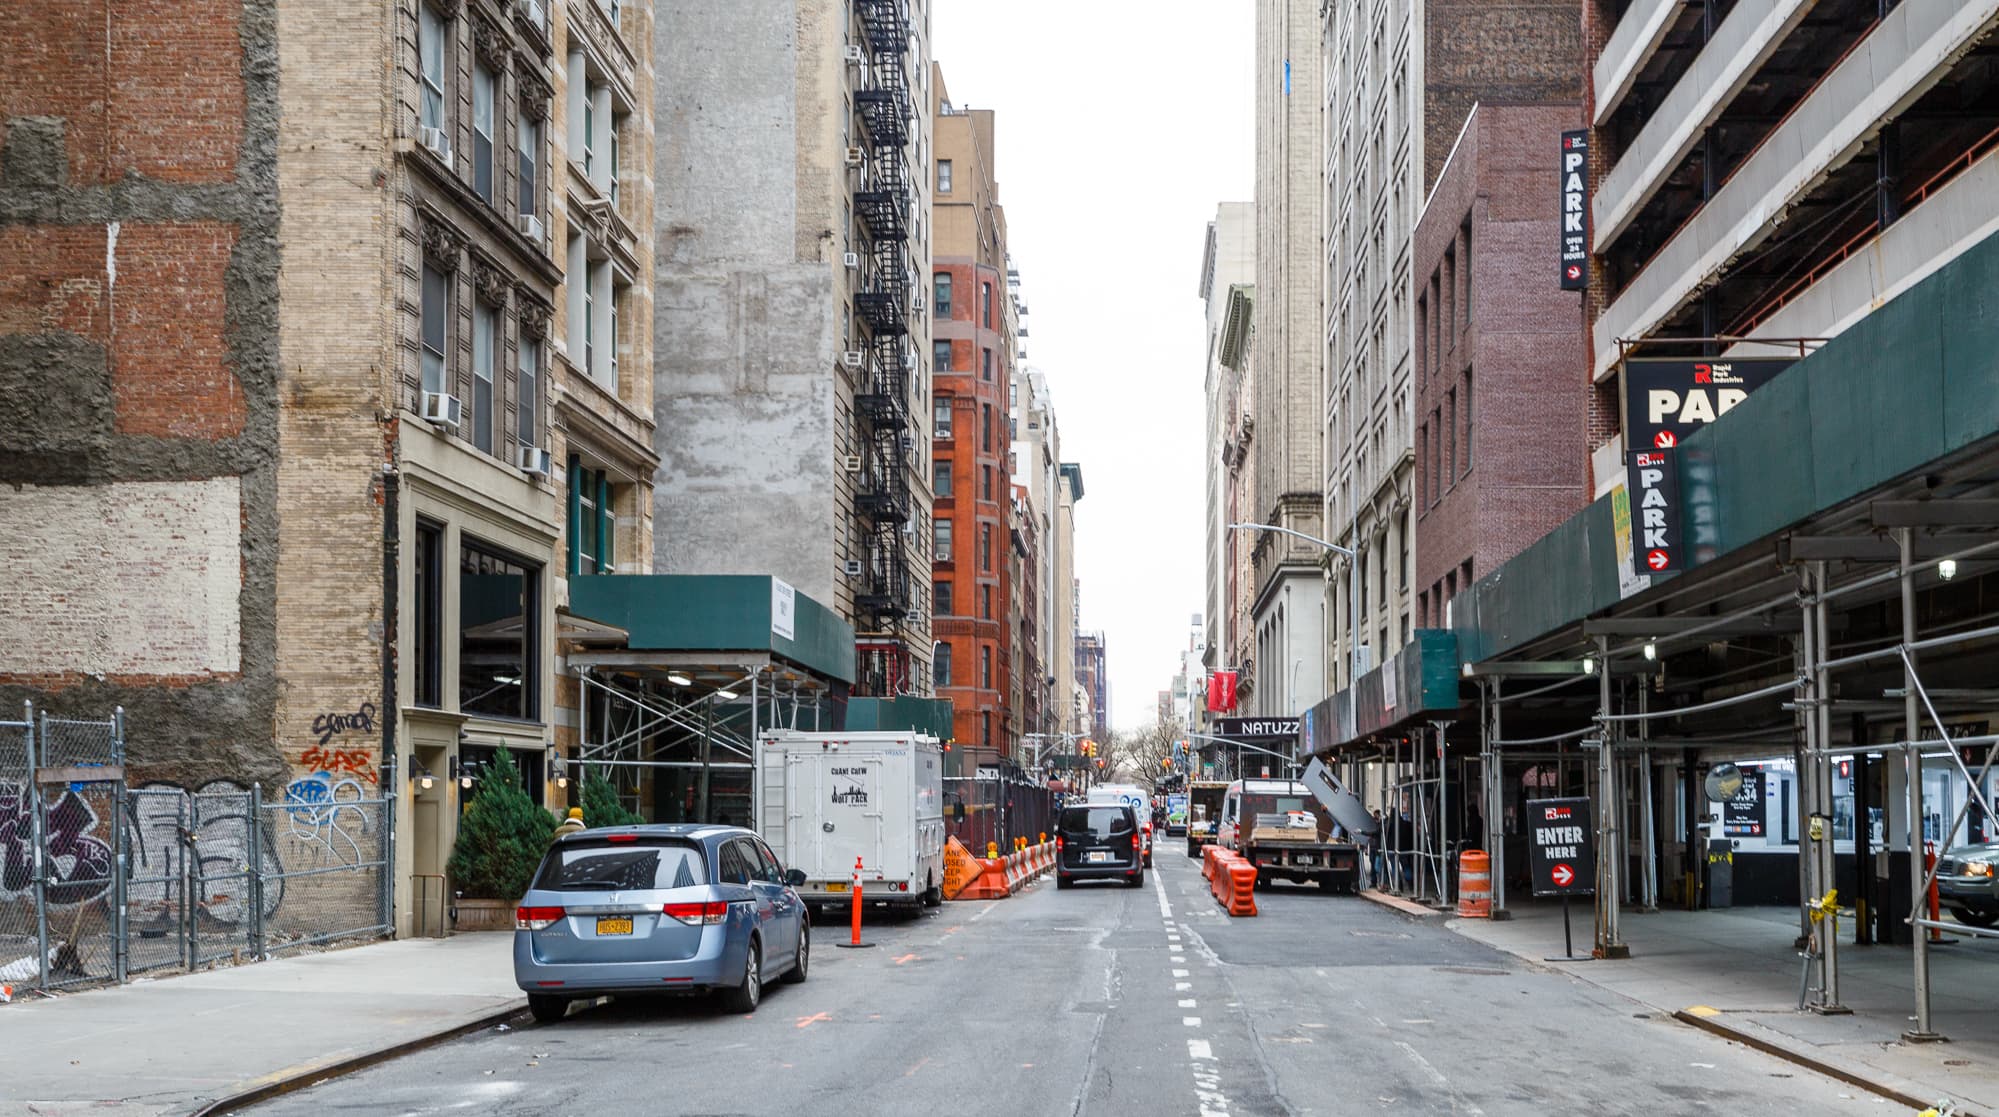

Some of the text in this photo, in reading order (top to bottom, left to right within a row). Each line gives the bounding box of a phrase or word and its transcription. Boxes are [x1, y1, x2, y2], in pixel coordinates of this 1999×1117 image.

[1565, 152, 1584, 232] PARK
[1566, 237, 1583, 245] OPEN
[1563, 251, 1586, 261] HOURS
[1641, 469, 1670, 548] PARK
[1535, 826, 1584, 845] ENTER
[1545, 846, 1577, 859] HERE
[946, 869, 960, 877] EEP
